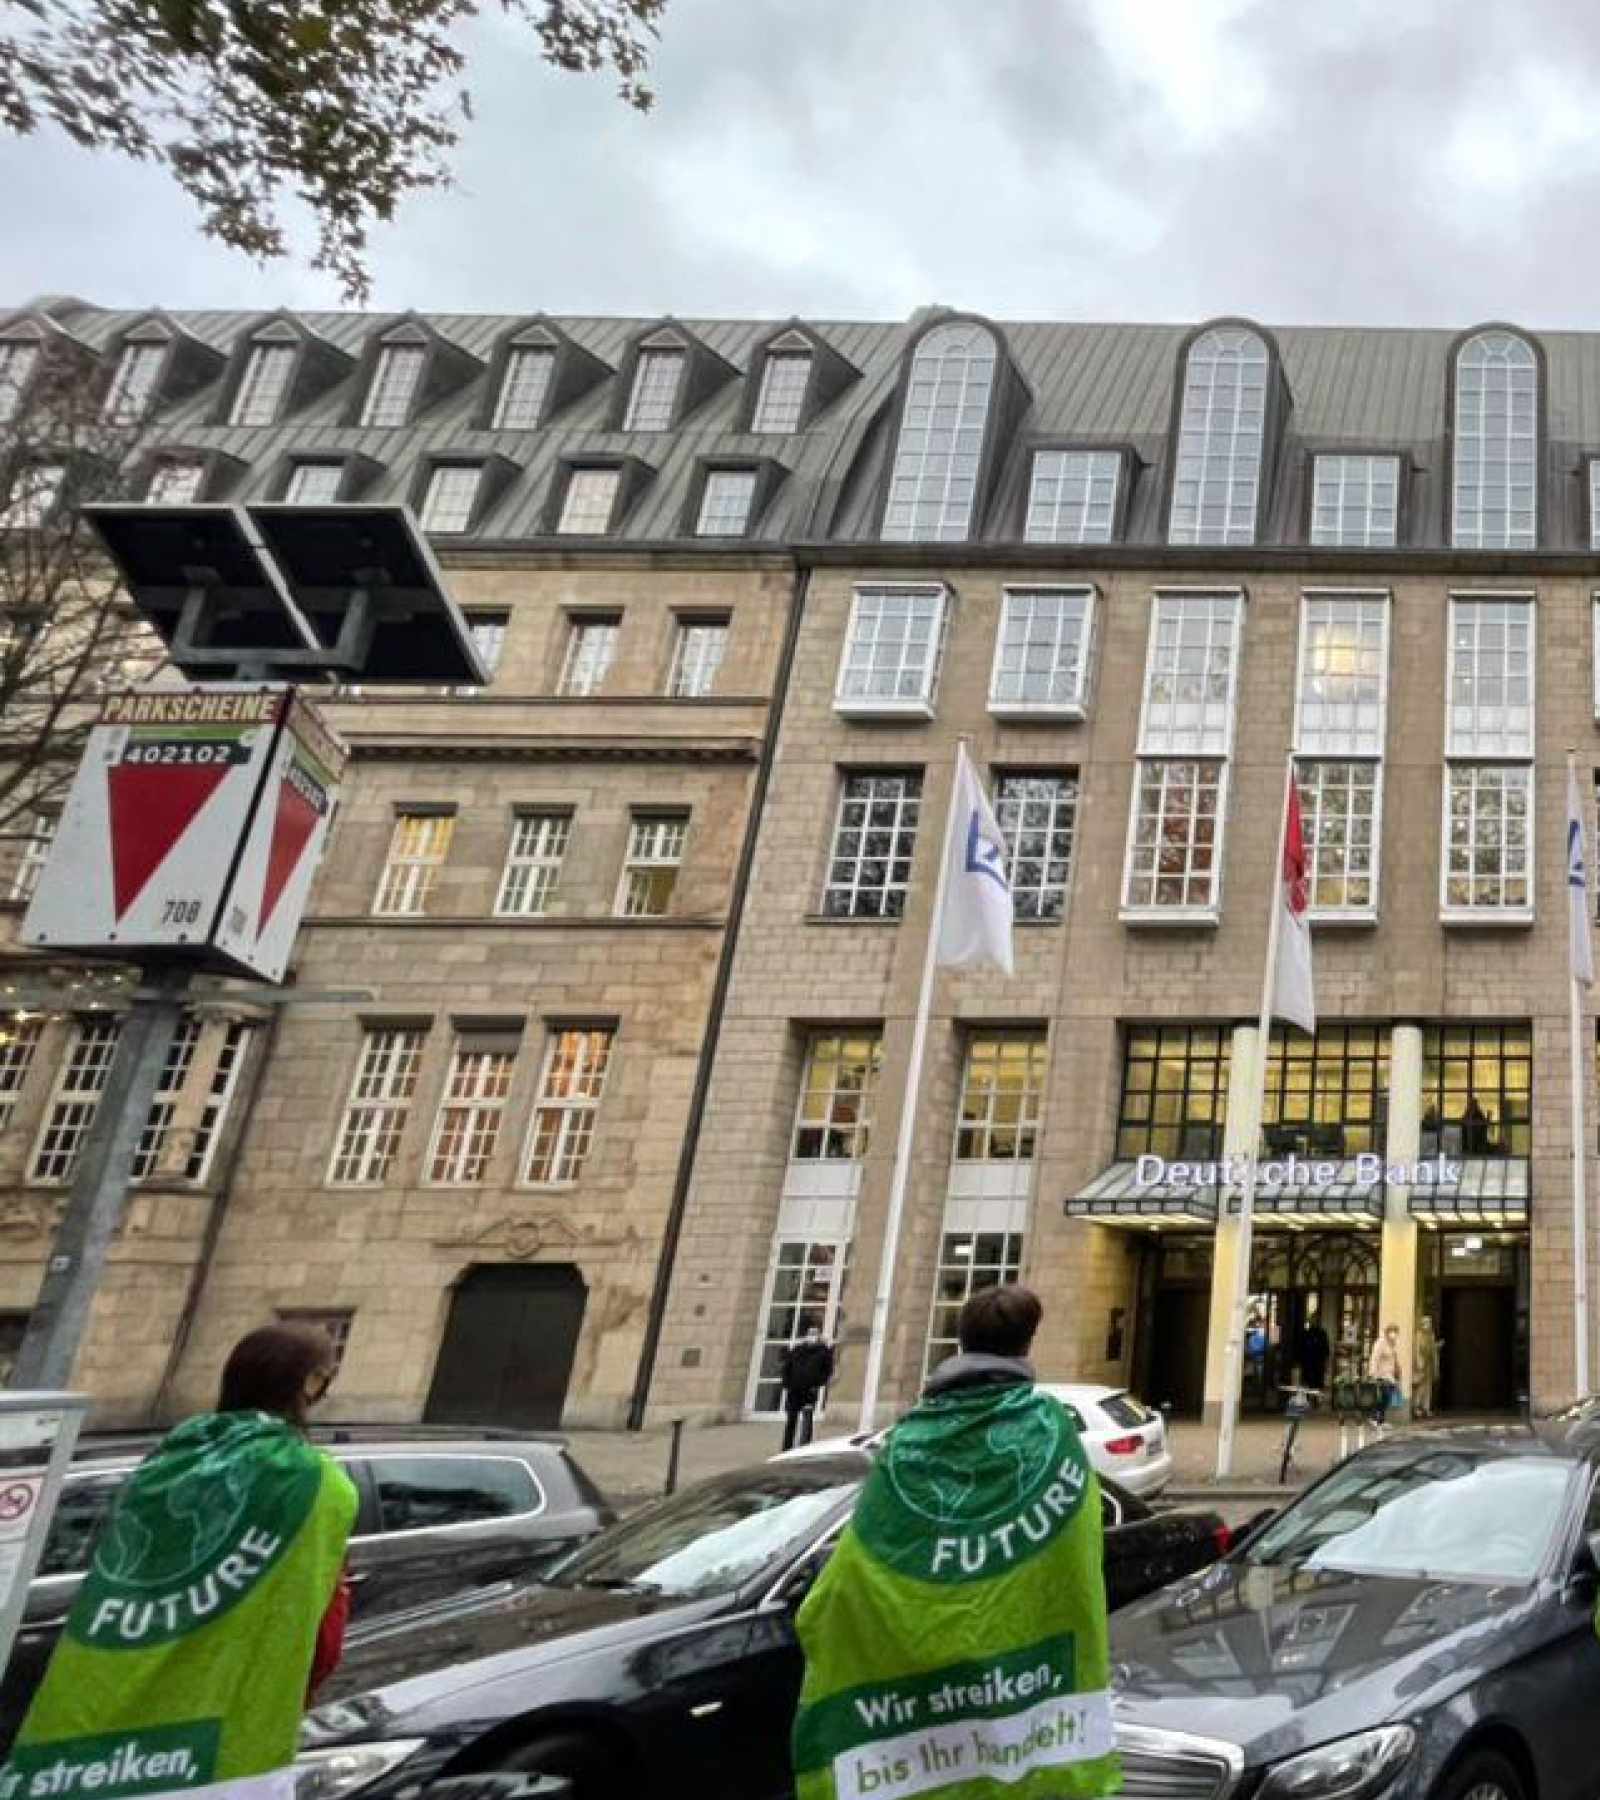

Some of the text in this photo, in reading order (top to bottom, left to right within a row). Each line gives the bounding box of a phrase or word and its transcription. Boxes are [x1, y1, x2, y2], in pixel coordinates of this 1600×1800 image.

[102, 695, 275, 720] PARKSCHEINE
[126, 746, 232, 763] 402102
[162, 901, 201, 923] 708
[1356, 1151, 1463, 1186] Bank
[931, 1457, 1085, 1573] FUTURE
[88, 1525, 281, 1640] FUTURE
[854, 1663, 1062, 1729] Wir streiken,
[29, 1741, 200, 1796] streiken,
[856, 1753, 911, 1793] bis
[919, 1739, 961, 1772] Ihr
